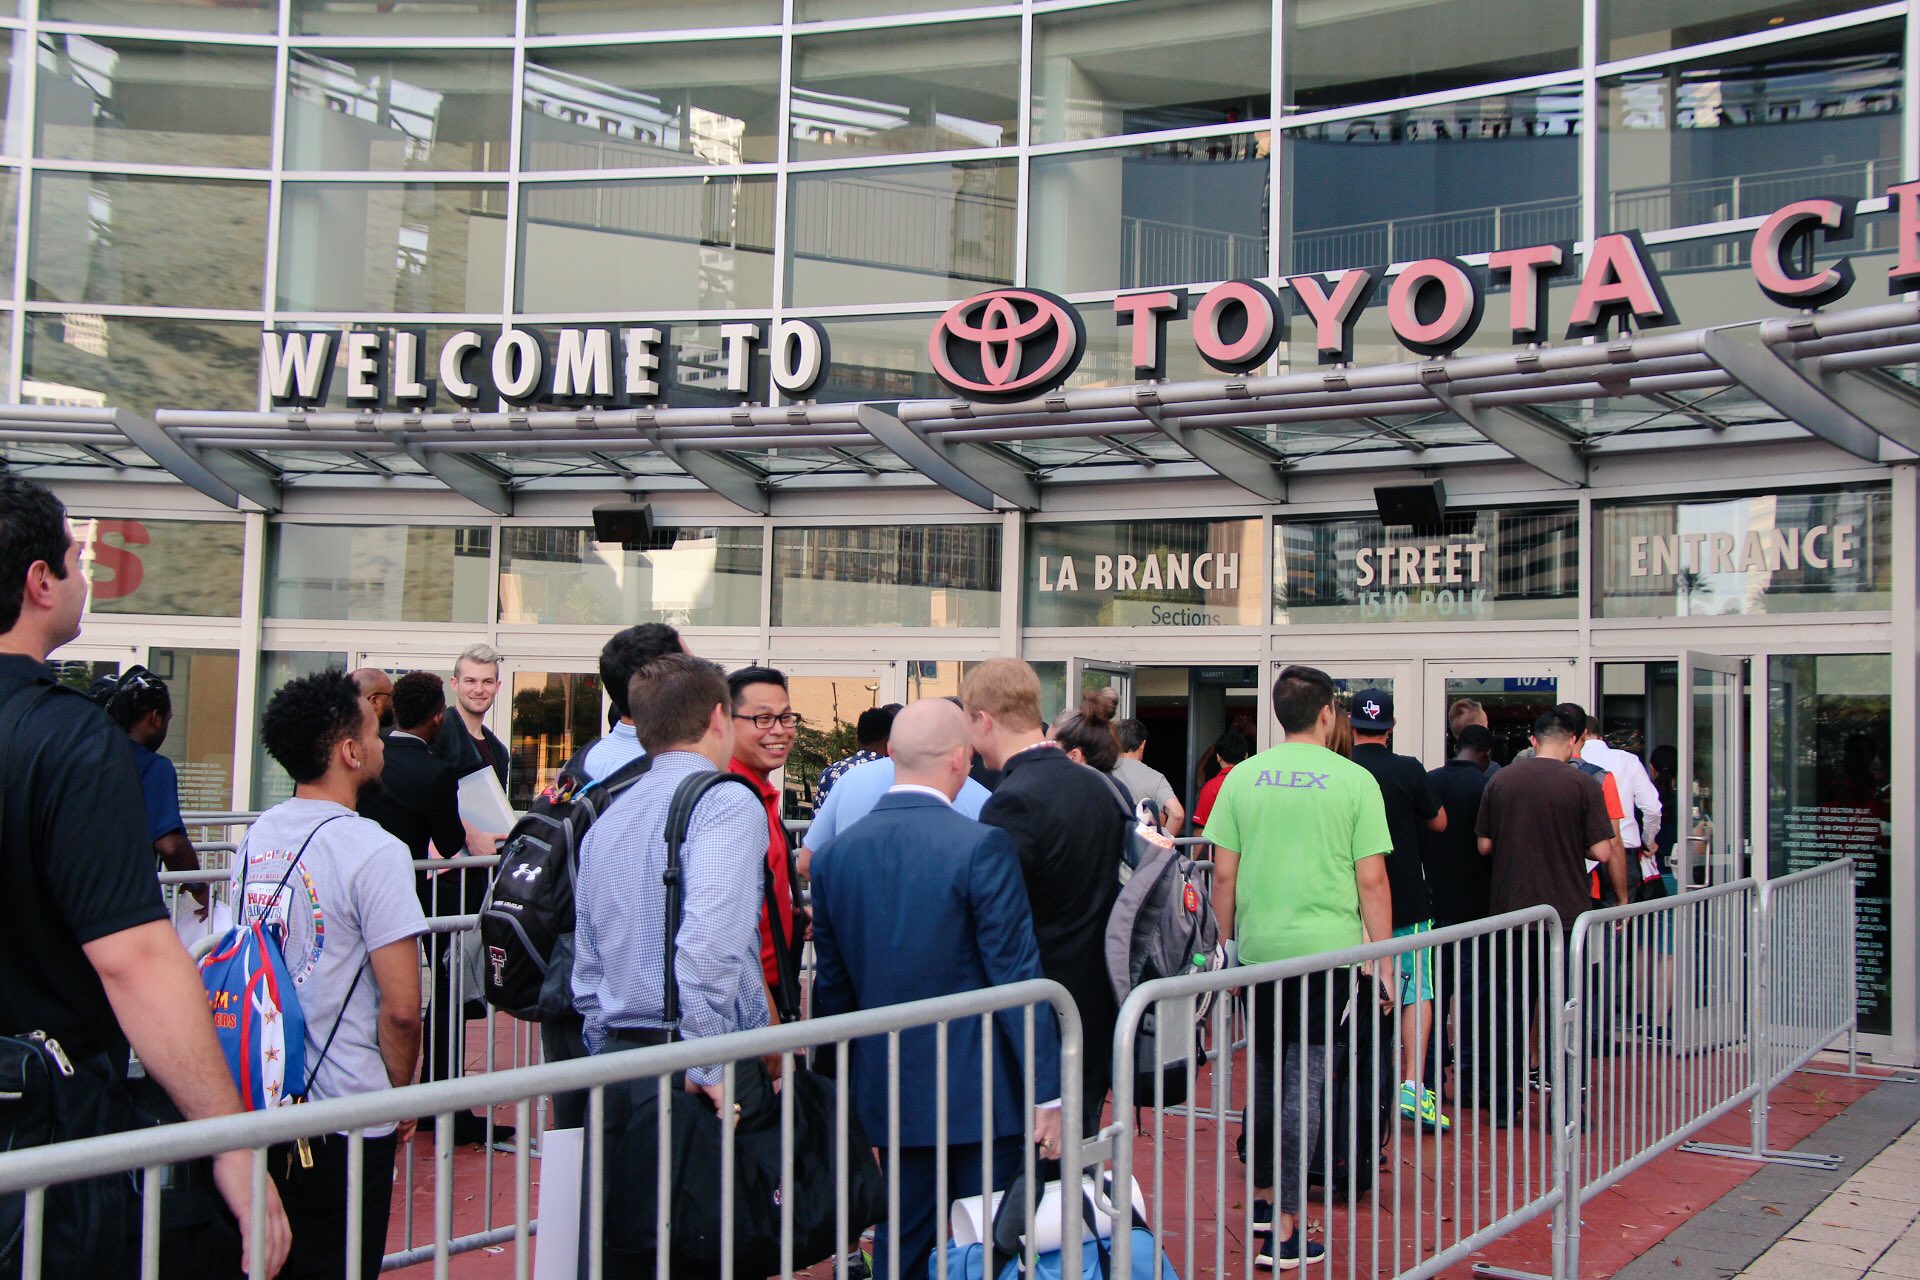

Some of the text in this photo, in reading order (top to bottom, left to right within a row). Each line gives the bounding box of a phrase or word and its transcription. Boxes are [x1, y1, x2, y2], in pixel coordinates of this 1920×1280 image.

[262, 327, 662, 399] WELCOME
[721, 320, 822, 392] TO
[1113, 233, 1665, 369] TOYOTA
[1039, 524, 1855, 592] LA BRANCH STREET ENTRANCE
[1151, 605, 1221, 626] Sections
[1358, 589, 1486, 618] 1510 POLK
[1255, 770, 1330, 790] ALEX
